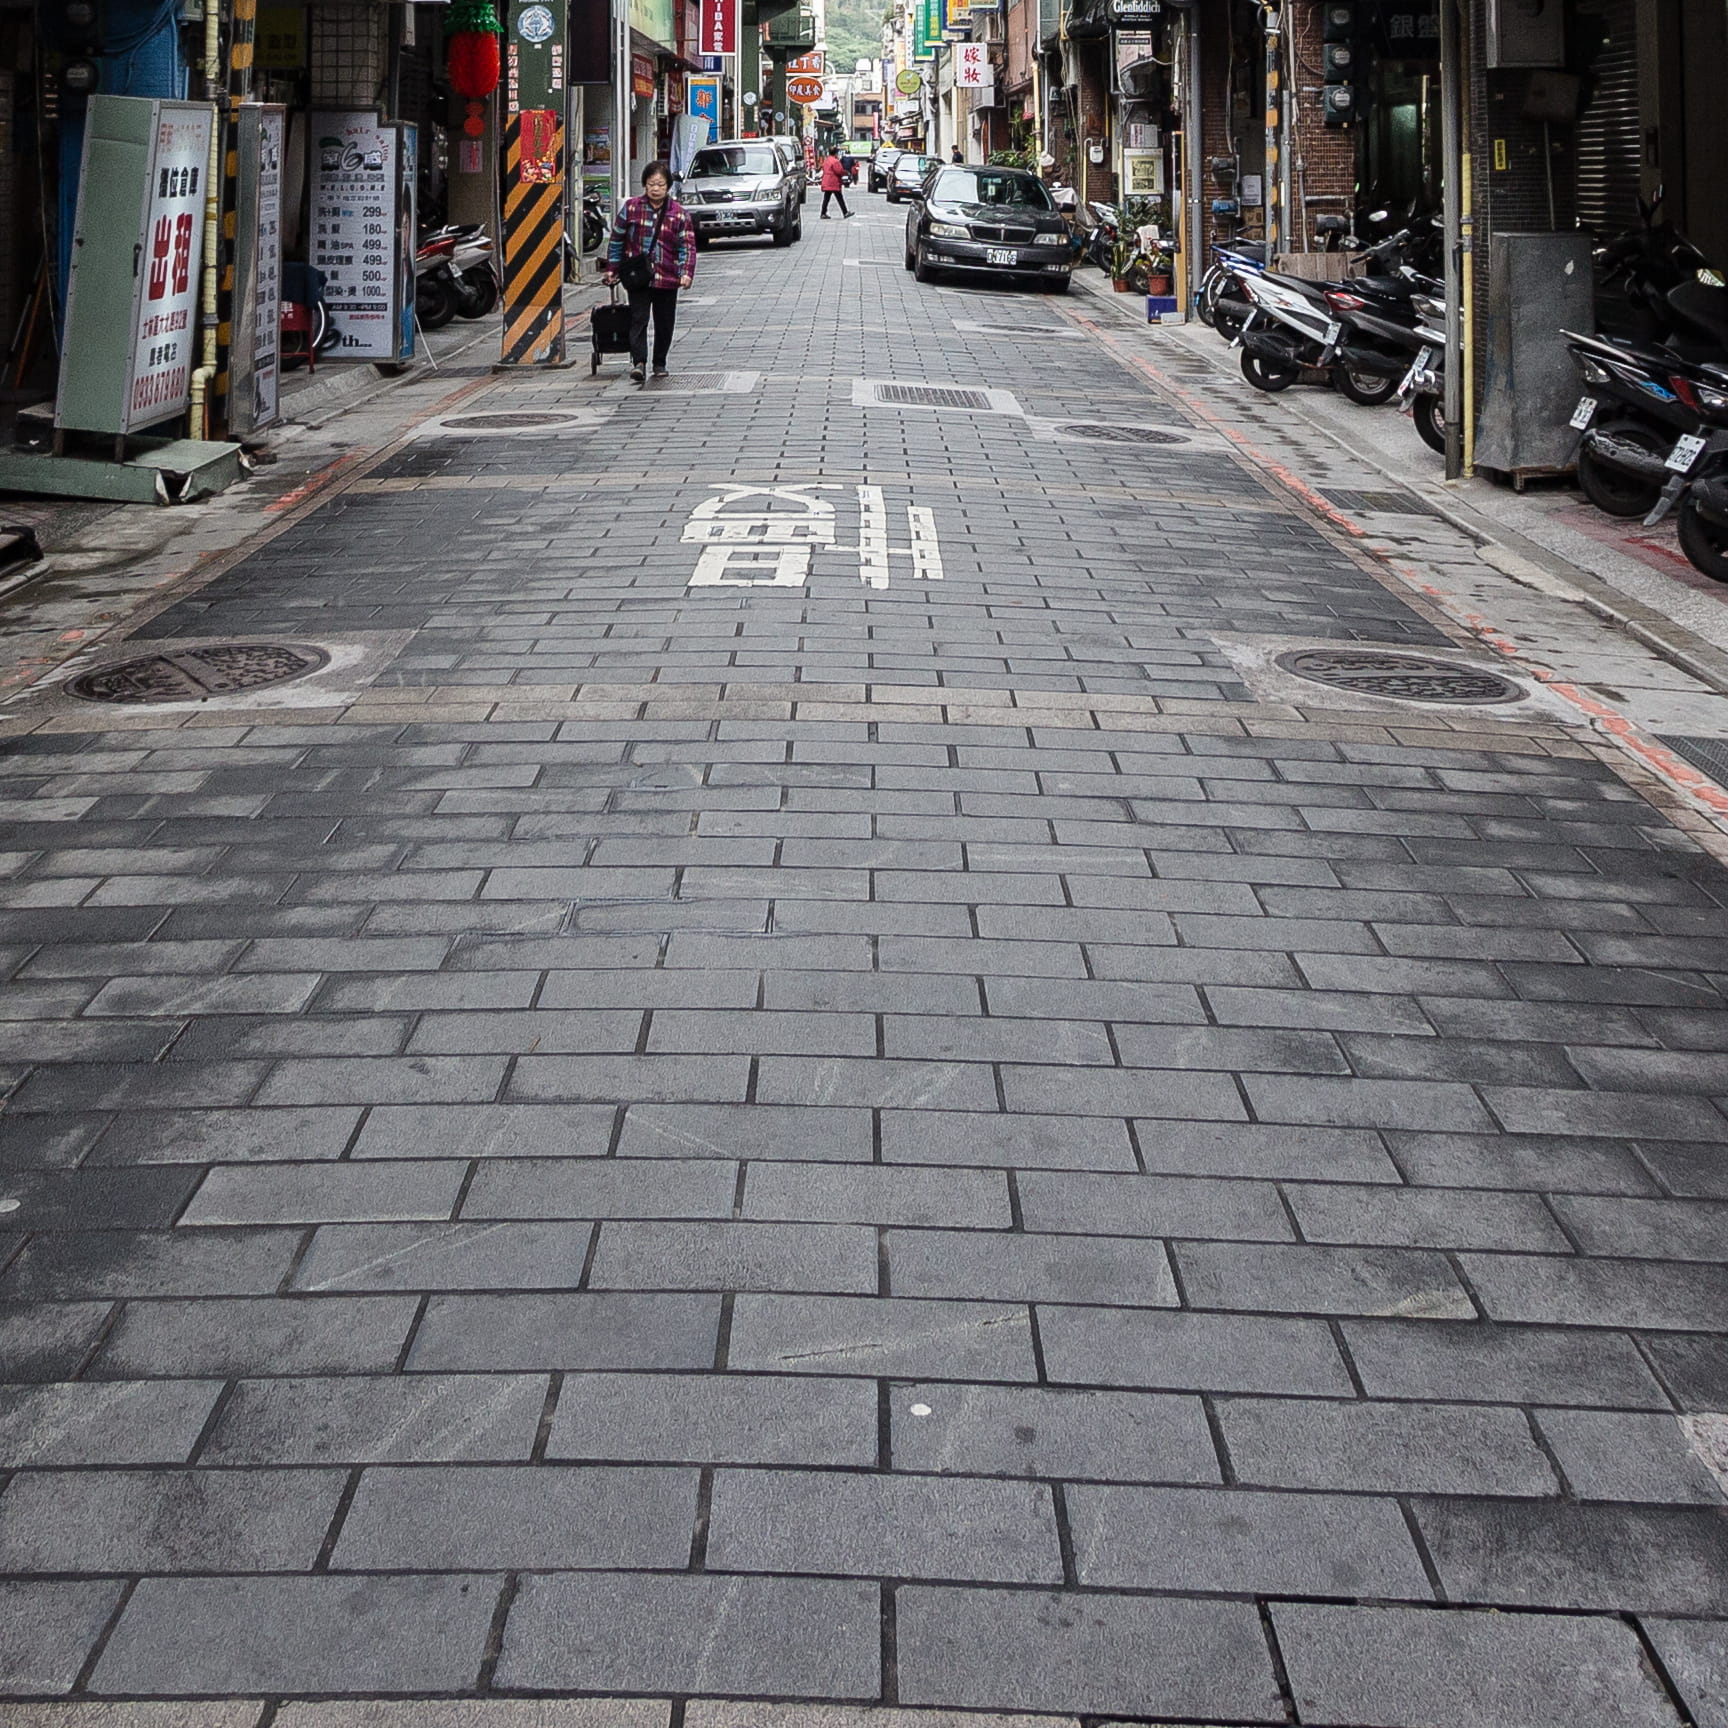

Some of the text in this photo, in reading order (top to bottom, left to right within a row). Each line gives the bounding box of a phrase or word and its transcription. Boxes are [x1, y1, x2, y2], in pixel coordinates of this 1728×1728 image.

[964, 47, 982, 84] 嫁妝
[362, 206, 381, 217] 299
[363, 223, 381, 234] 180
[362, 239, 381, 250] 499
[148, 213, 193, 301] 出租
[362, 255, 381, 265] 499
[362, 271, 381, 281] 500
[362, 286, 381, 297] 1000
